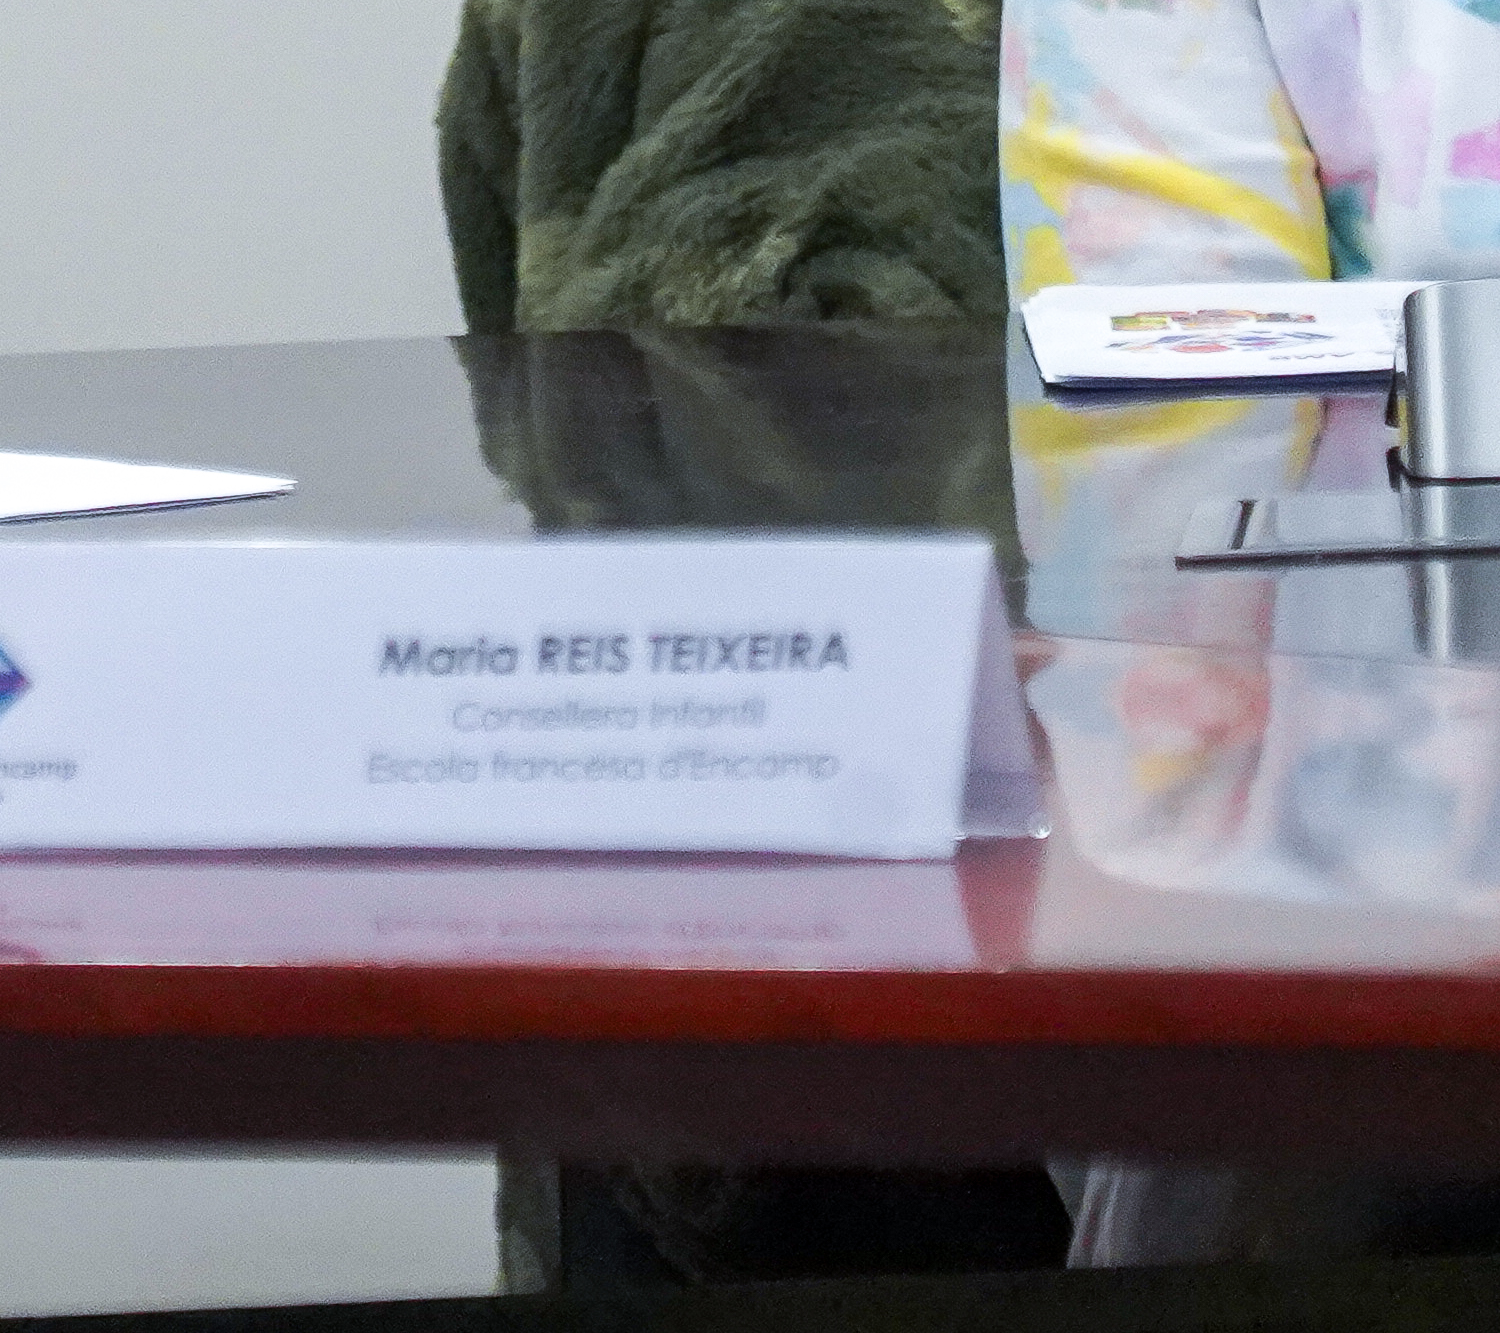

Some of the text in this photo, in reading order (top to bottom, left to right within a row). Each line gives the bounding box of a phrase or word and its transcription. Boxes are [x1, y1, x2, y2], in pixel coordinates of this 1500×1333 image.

[378, 631, 848, 677] Maria REIS TEIXEIRA
[452, 696, 767, 734] Consellera Infantil
[367, 750, 479, 786] Escola
[492, 749, 647, 784] francesa
